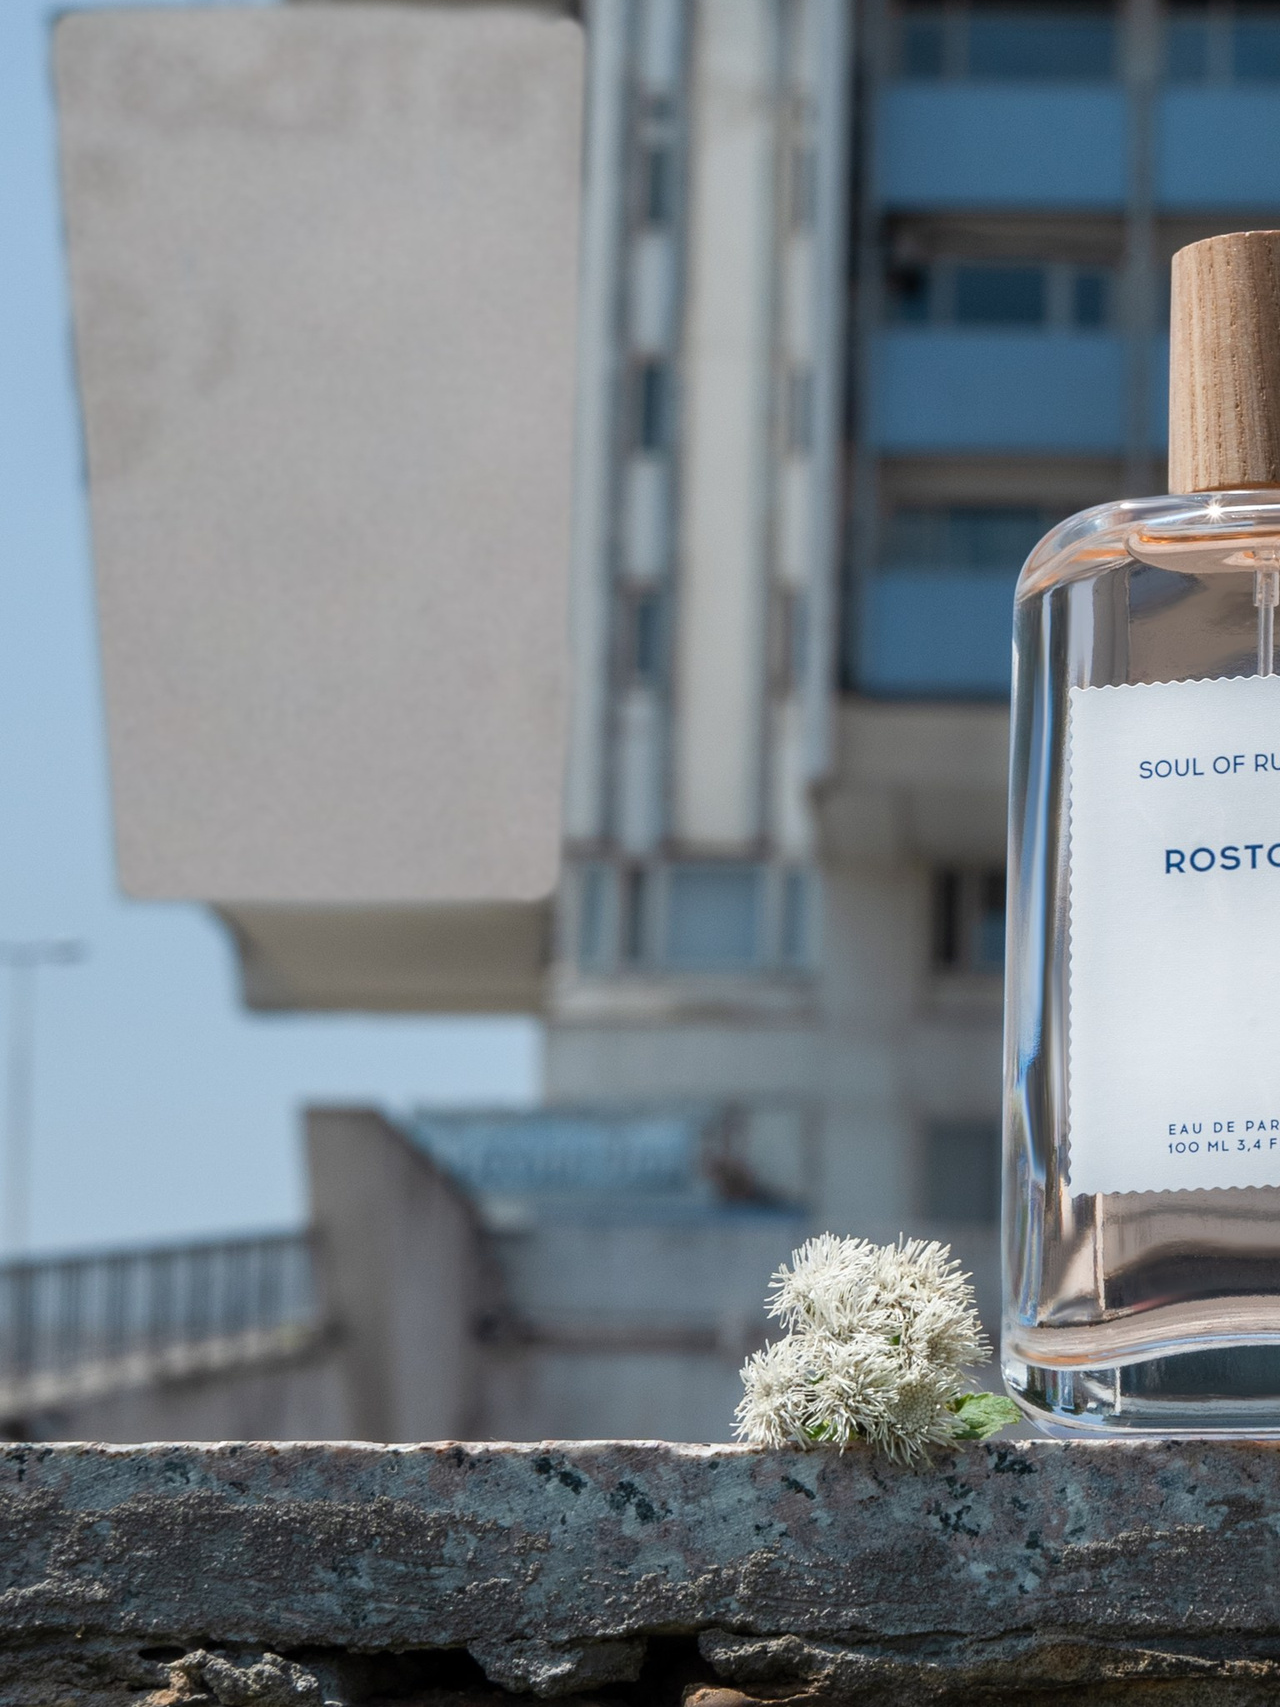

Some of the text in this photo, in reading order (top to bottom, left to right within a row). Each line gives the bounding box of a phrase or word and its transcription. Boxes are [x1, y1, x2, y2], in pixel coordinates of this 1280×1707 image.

[1139, 757, 1204, 779] SOUL
[1213, 754, 1245, 774] OF
[1168, 1123, 1202, 1135] EAU
[1213, 1121, 1235, 1133] DE
[1168, 1141, 1199, 1154] 100
[1207, 1140, 1229, 1152] ML
[1237, 1138, 1261, 1152] 3,4
